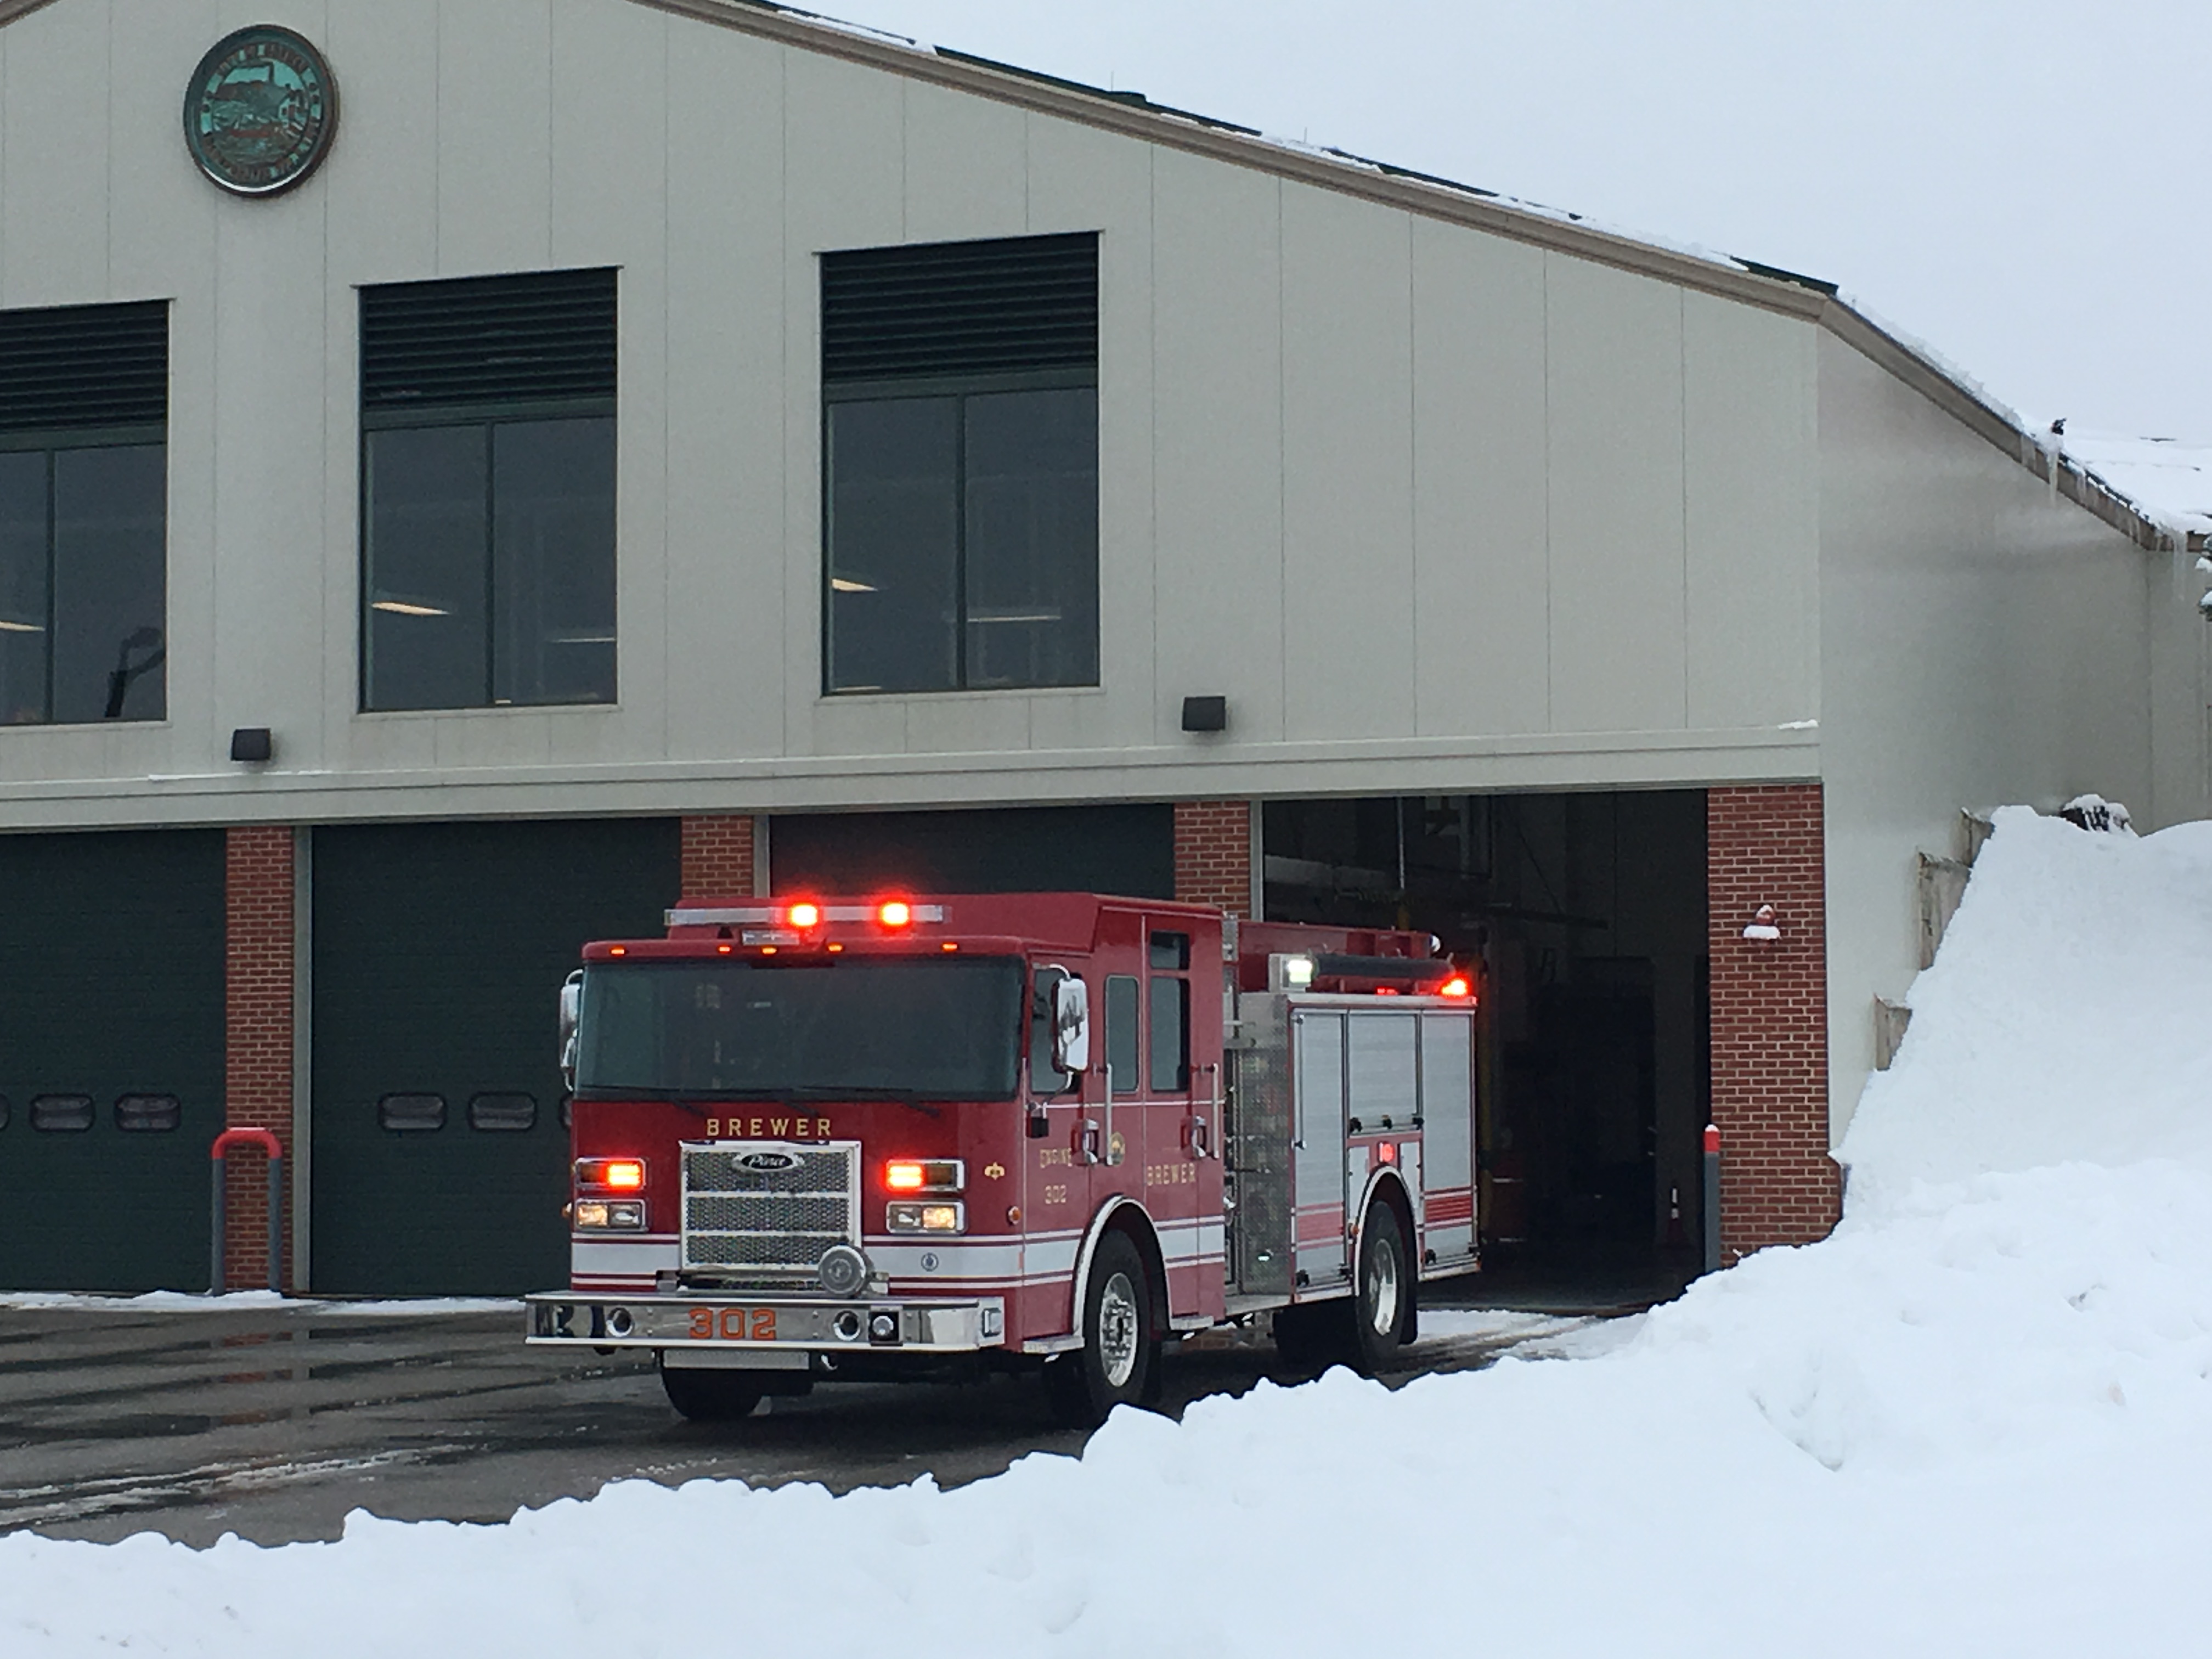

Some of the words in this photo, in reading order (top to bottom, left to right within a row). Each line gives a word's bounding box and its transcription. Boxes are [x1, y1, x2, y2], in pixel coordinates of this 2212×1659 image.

[707, 1119, 831, 1136] BREWER
[1147, 1163, 1195, 1186] BREWER
[1045, 1185, 1066, 1204] 302
[689, 1307, 776, 1340] 302
